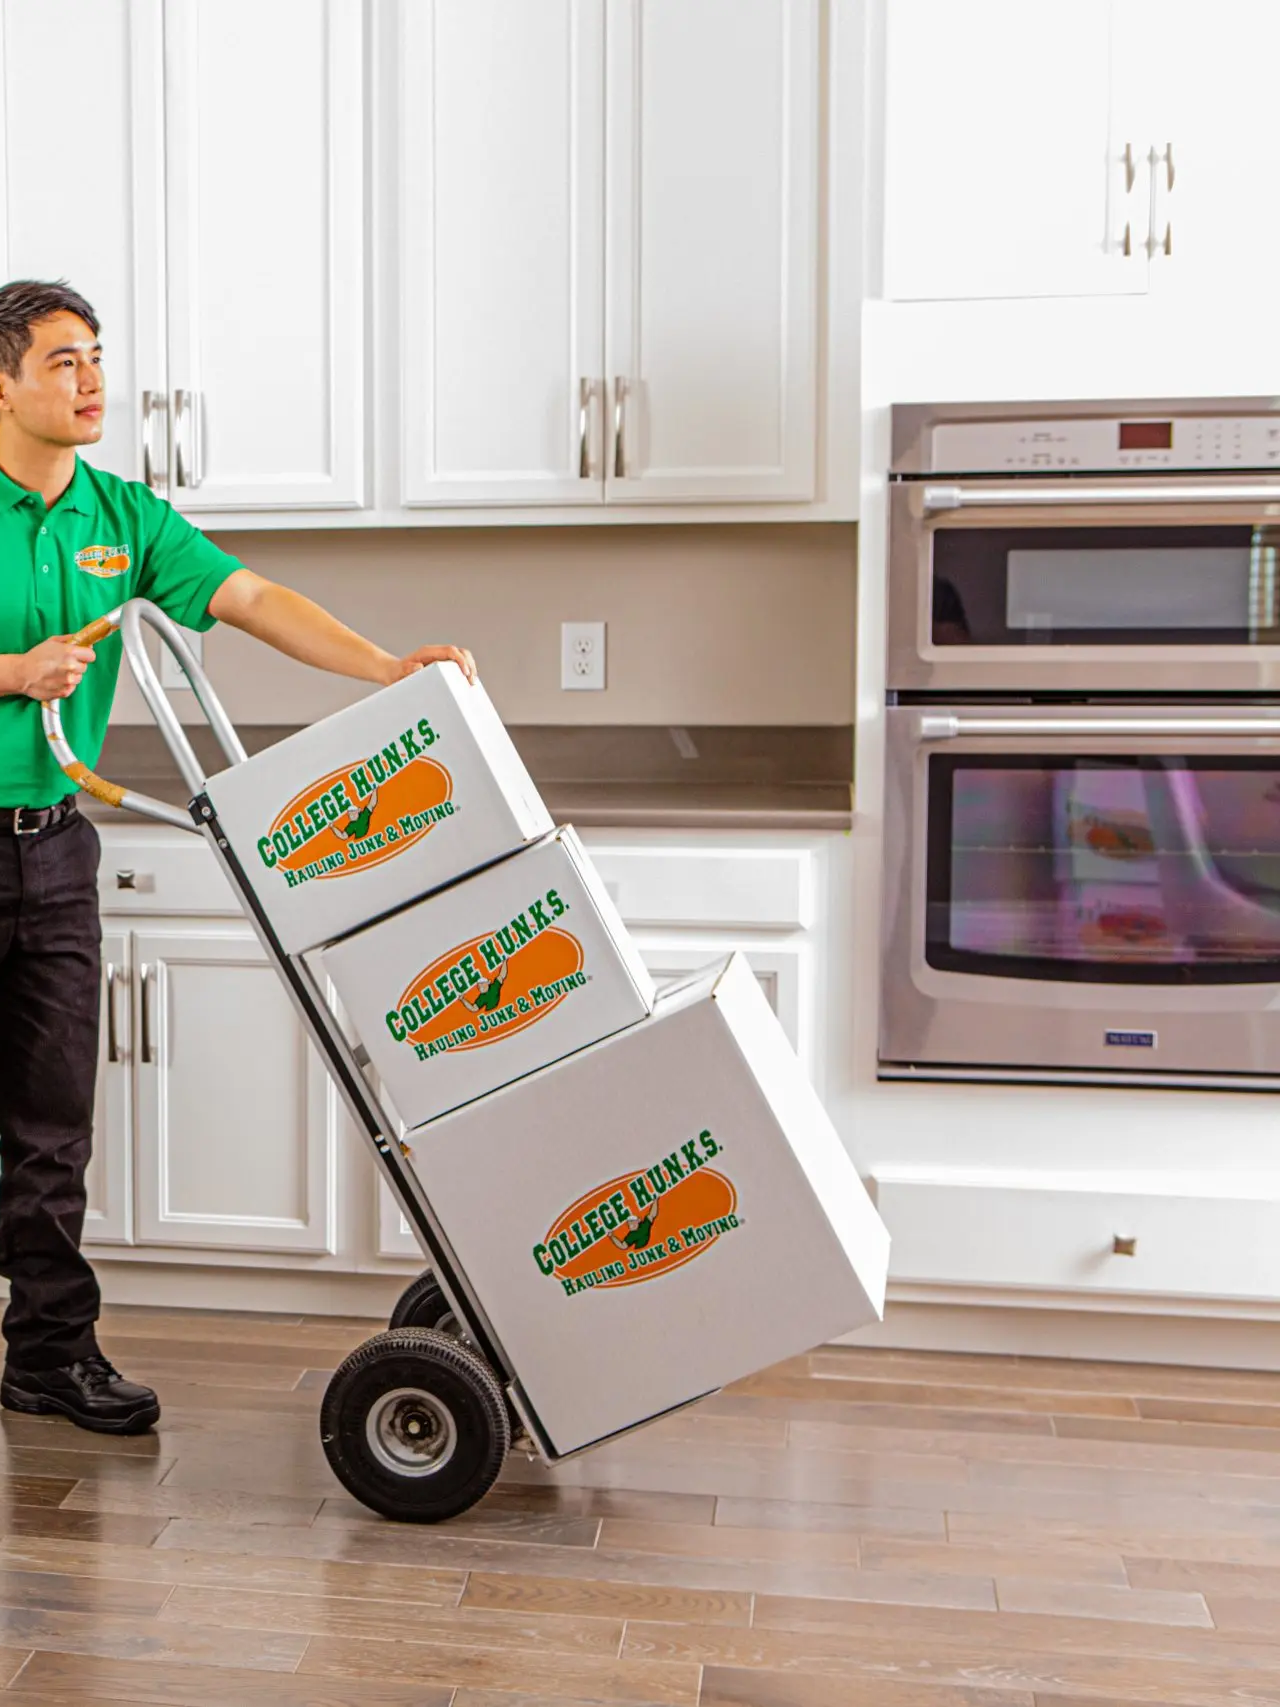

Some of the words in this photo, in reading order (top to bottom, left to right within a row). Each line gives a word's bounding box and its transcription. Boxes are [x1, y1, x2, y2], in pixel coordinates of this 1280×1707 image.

[257, 783, 351, 868] COLLEGE
[350, 718, 440, 798] H.U.N.K.S.
[284, 852, 345, 888] HAULING
[348, 835, 386, 861] JUNK
[386, 826, 400, 842] &
[399, 801, 455, 836] MOVING
[386, 955, 481, 1042] COLLEGE
[479, 889, 570, 971] H.U.N.K.S.
[413, 1024, 476, 1061] HAULING
[479, 1005, 517, 1032] JUNK
[517, 998, 531, 1013] &
[530, 971, 587, 1006] MOVING
[532, 1192, 631, 1276] COLLEGE
[629, 1129, 723, 1208] H.U.N.K.S.
[561, 1261, 624, 1296] HAULING
[628, 1245, 668, 1270] JUNK
[668, 1237, 682, 1253] &
[680, 1214, 739, 1247] MOVING
